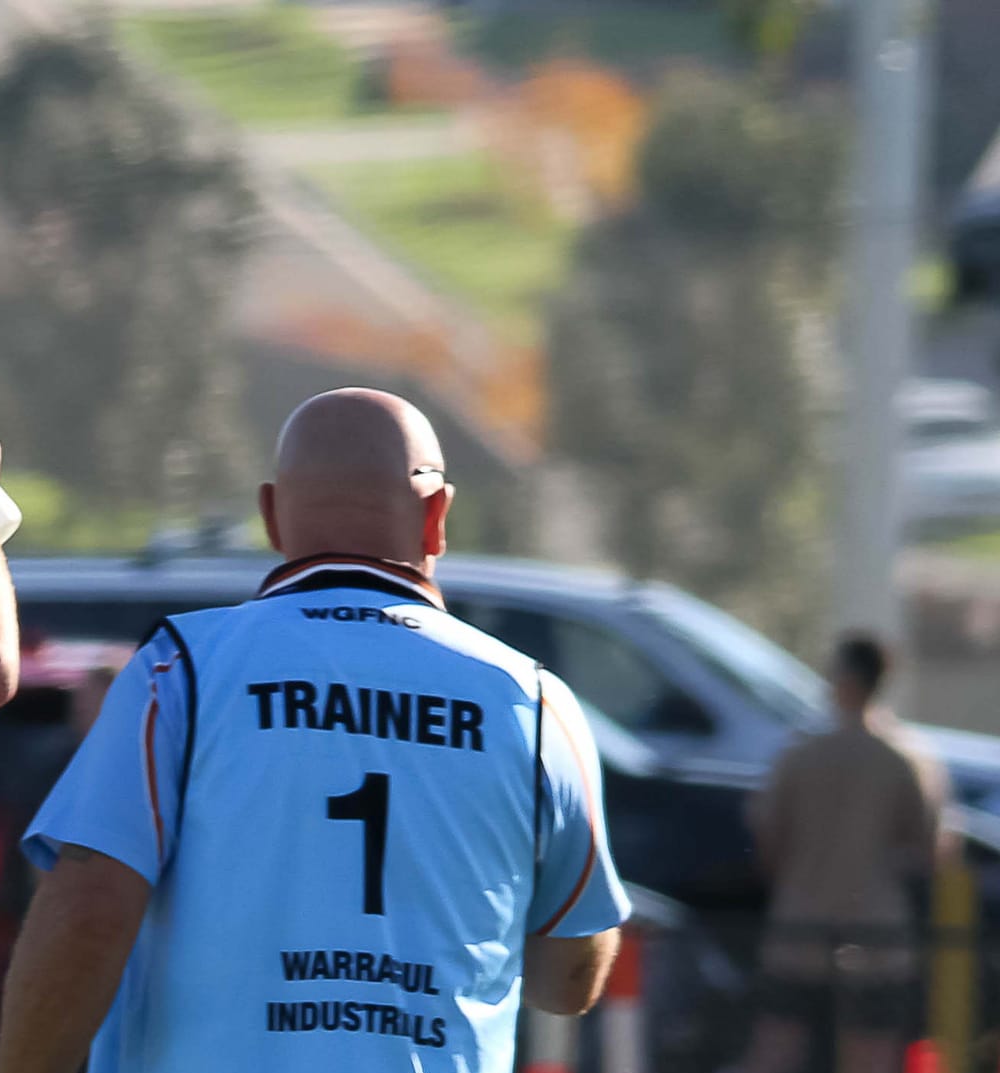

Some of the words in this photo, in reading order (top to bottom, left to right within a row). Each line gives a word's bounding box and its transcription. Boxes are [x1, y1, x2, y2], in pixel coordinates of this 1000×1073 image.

[300, 606, 422, 630] WGFNC
[247, 680, 485, 752] TRAINER
[326, 771, 390, 916] 1
[266, 1001, 446, 1048] INDUSTRILS
